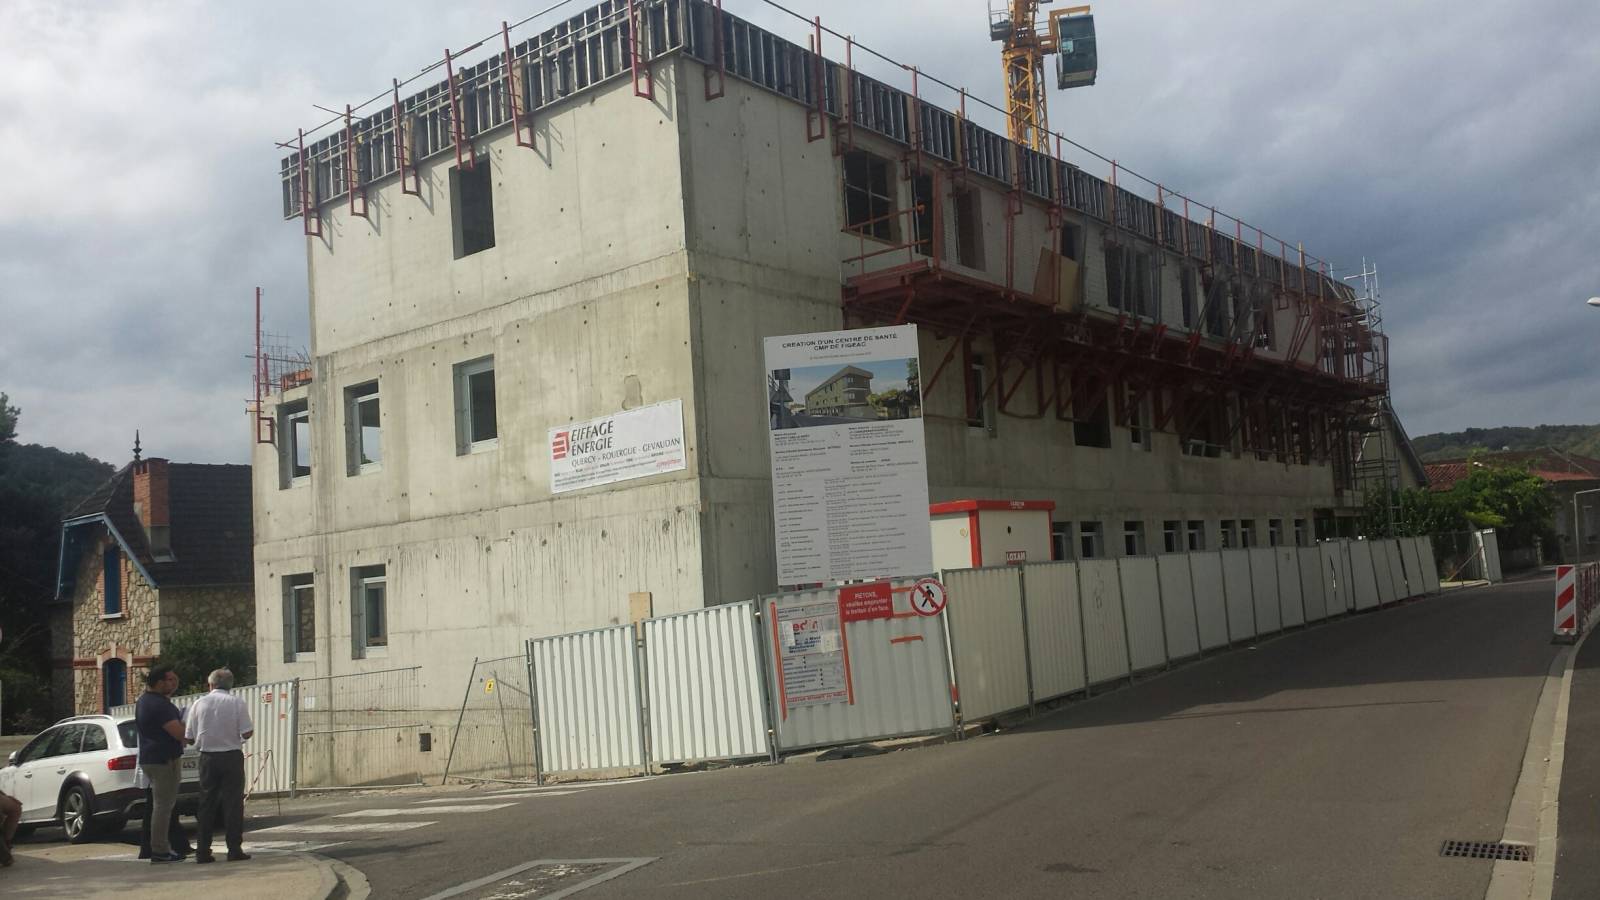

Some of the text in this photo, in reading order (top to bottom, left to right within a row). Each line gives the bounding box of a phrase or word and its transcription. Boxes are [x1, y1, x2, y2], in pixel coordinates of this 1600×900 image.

[835, 336, 862, 344] CENTRE
[841, 341, 866, 349] FIGEAC
[570, 420, 614, 442] EIFFAGE
[571, 436, 613, 457] ÉNERGIE
[571, 455, 597, 468] QUERCY
[602, 446, 637, 460] ROUERGUE
[642, 437, 681, 453] GEVAUDAN
[1006, 551, 1025, 561] LOXAM
